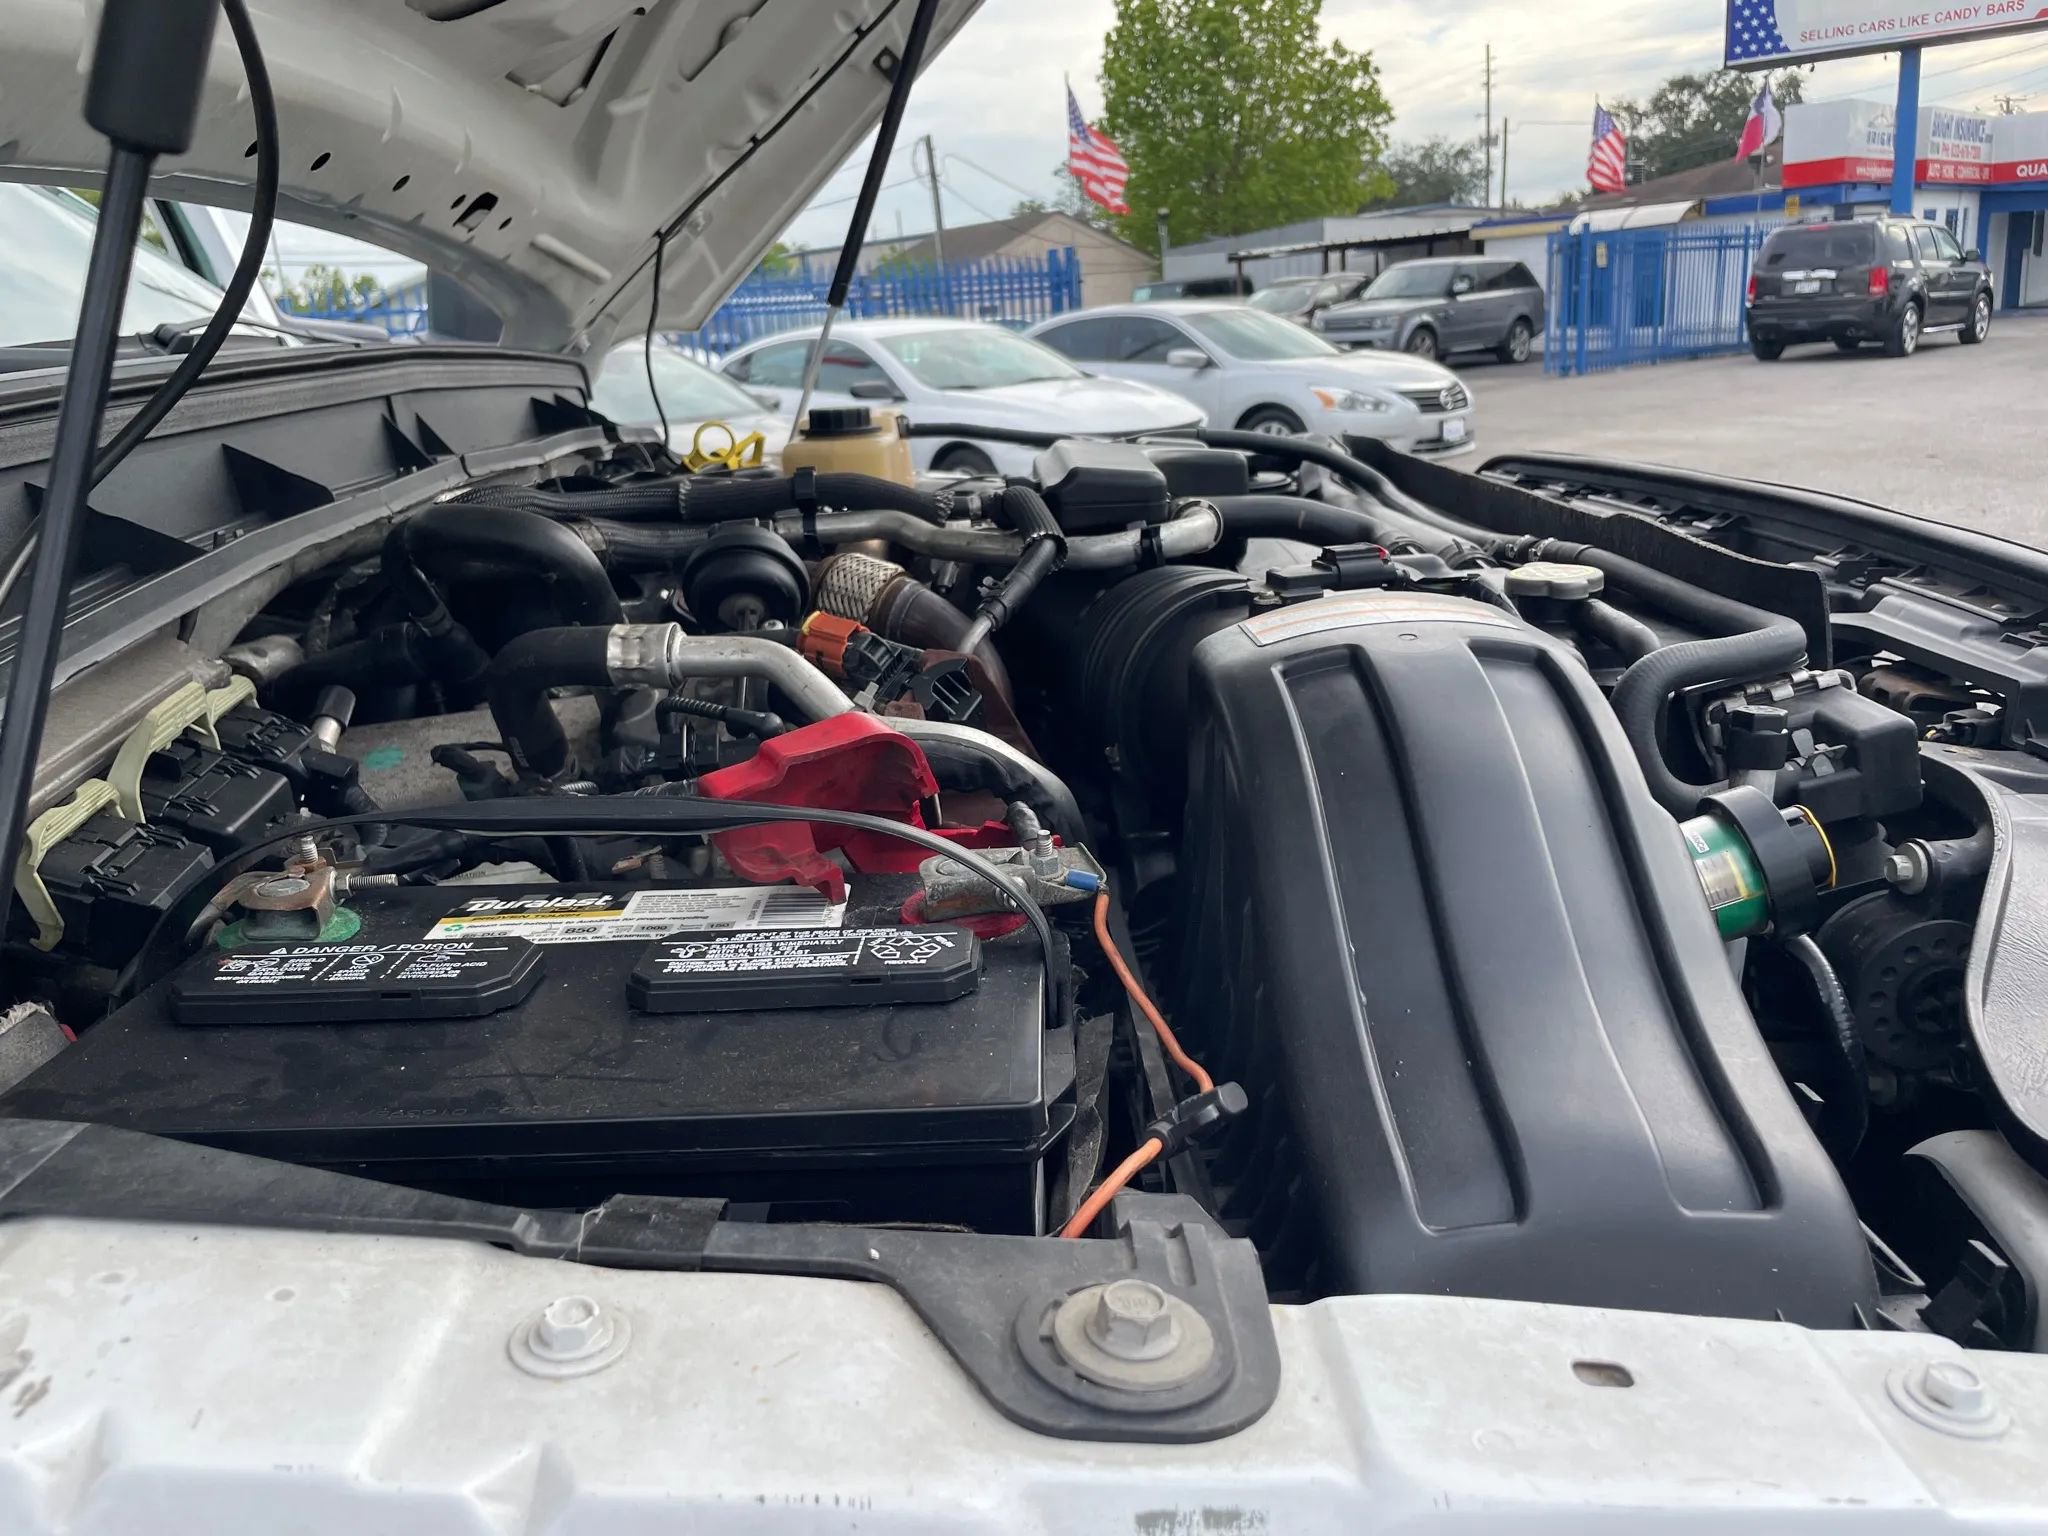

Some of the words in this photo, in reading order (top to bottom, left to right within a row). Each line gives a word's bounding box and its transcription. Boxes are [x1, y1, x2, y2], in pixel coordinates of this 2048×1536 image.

[1800, 25, 1855, 42] SELLING
[1859, 19, 1895, 34] CARS
[1899, 13, 1930, 28] LIKE
[1934, 6, 1982, 23] CANDY
[1986, 0, 2025, 16] BARS
[1866, 130, 1896, 146] BRIGH
[466, 895, 613, 912] Duralast
[564, 926, 597, 934] 850
[291, 945, 377, 954] DANGER
[397, 942, 473, 951] POISON
